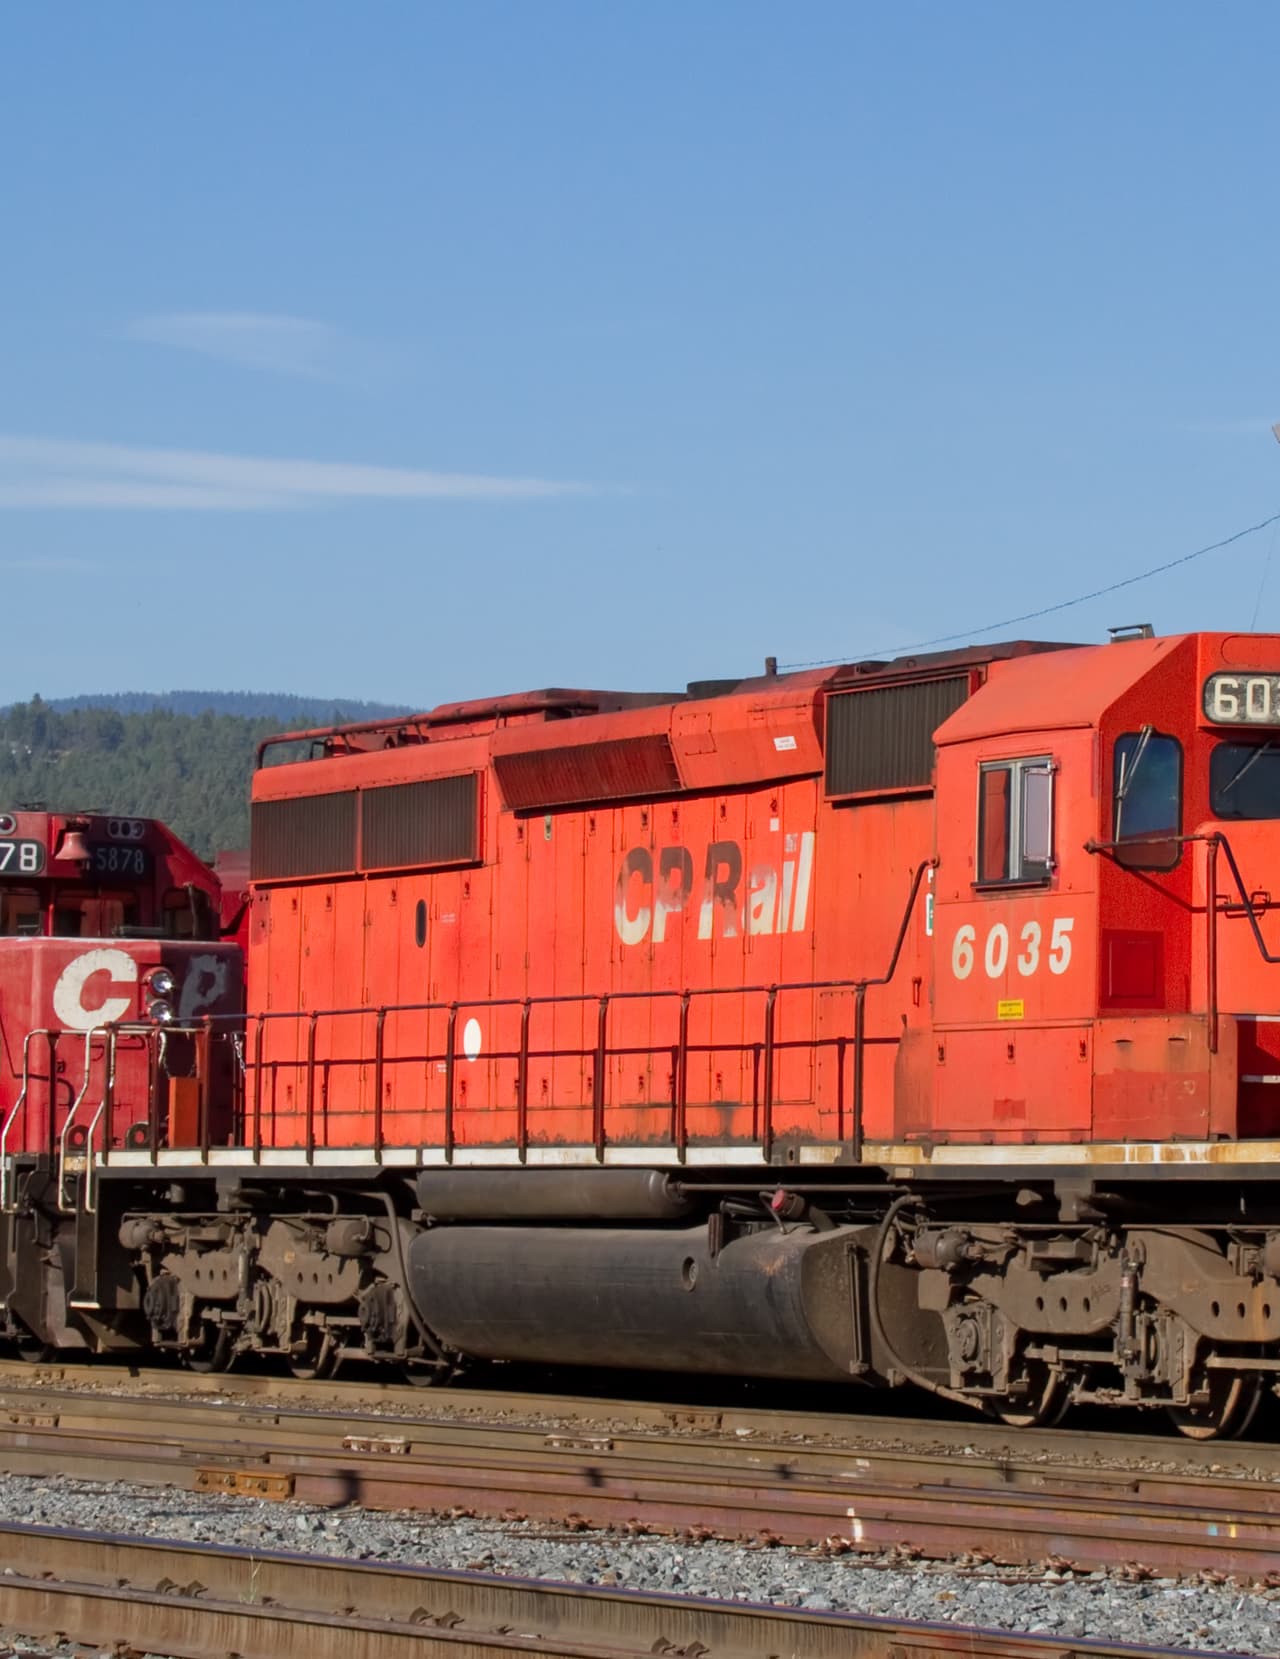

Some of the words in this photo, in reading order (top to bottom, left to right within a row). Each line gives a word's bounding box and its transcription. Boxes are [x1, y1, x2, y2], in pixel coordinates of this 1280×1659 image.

[96, 847, 145, 874] 5878
[614, 846, 694, 946] CP
[697, 831, 816, 941] Rail
[951, 917, 1075, 980] 6035
